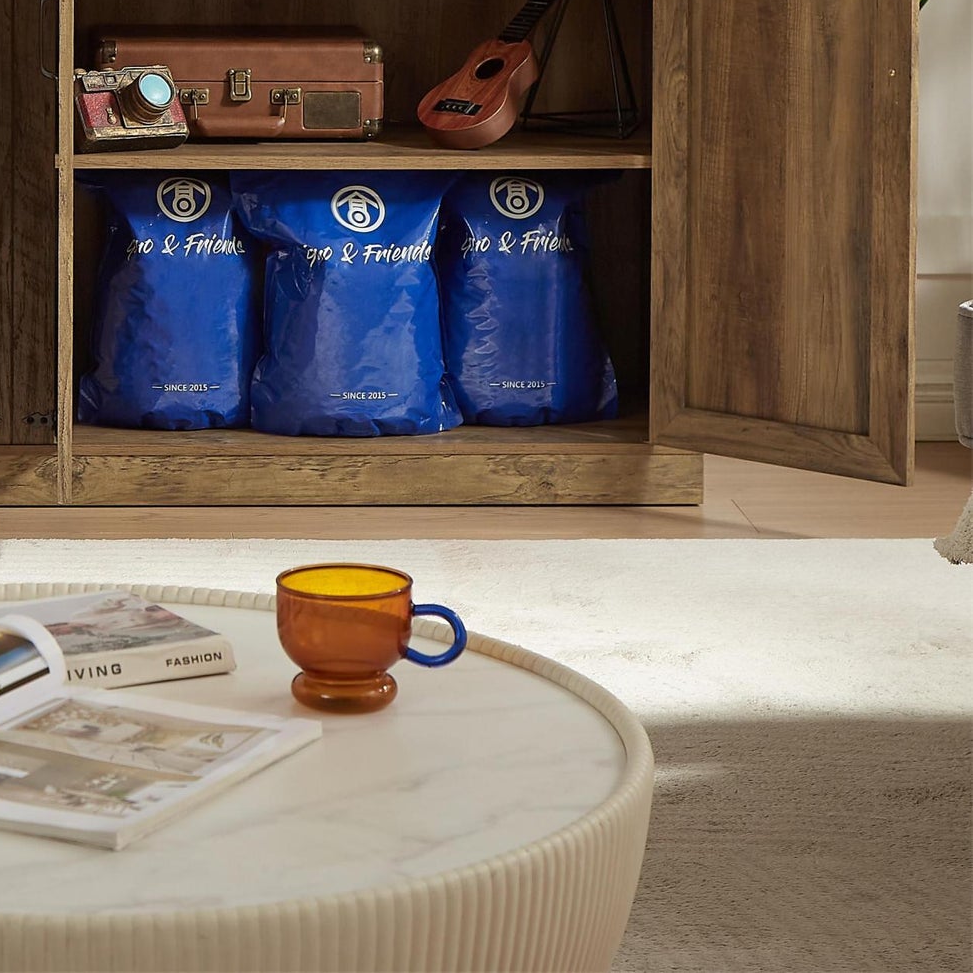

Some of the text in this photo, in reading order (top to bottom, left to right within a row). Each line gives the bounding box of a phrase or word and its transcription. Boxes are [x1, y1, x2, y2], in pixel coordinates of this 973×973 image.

[162, 234, 180, 256] &
[498, 231, 517, 253] &
[341, 243, 358, 264] &
[362, 240, 432, 264] Friends
[164, 383, 208, 392] SINCE 2015
[502, 380, 545, 389] SINCE 2015
[342, 391, 387, 400] SINCE 2015
[166, 651, 223, 668] FASHION
[67, 663, 122, 681] IVING
